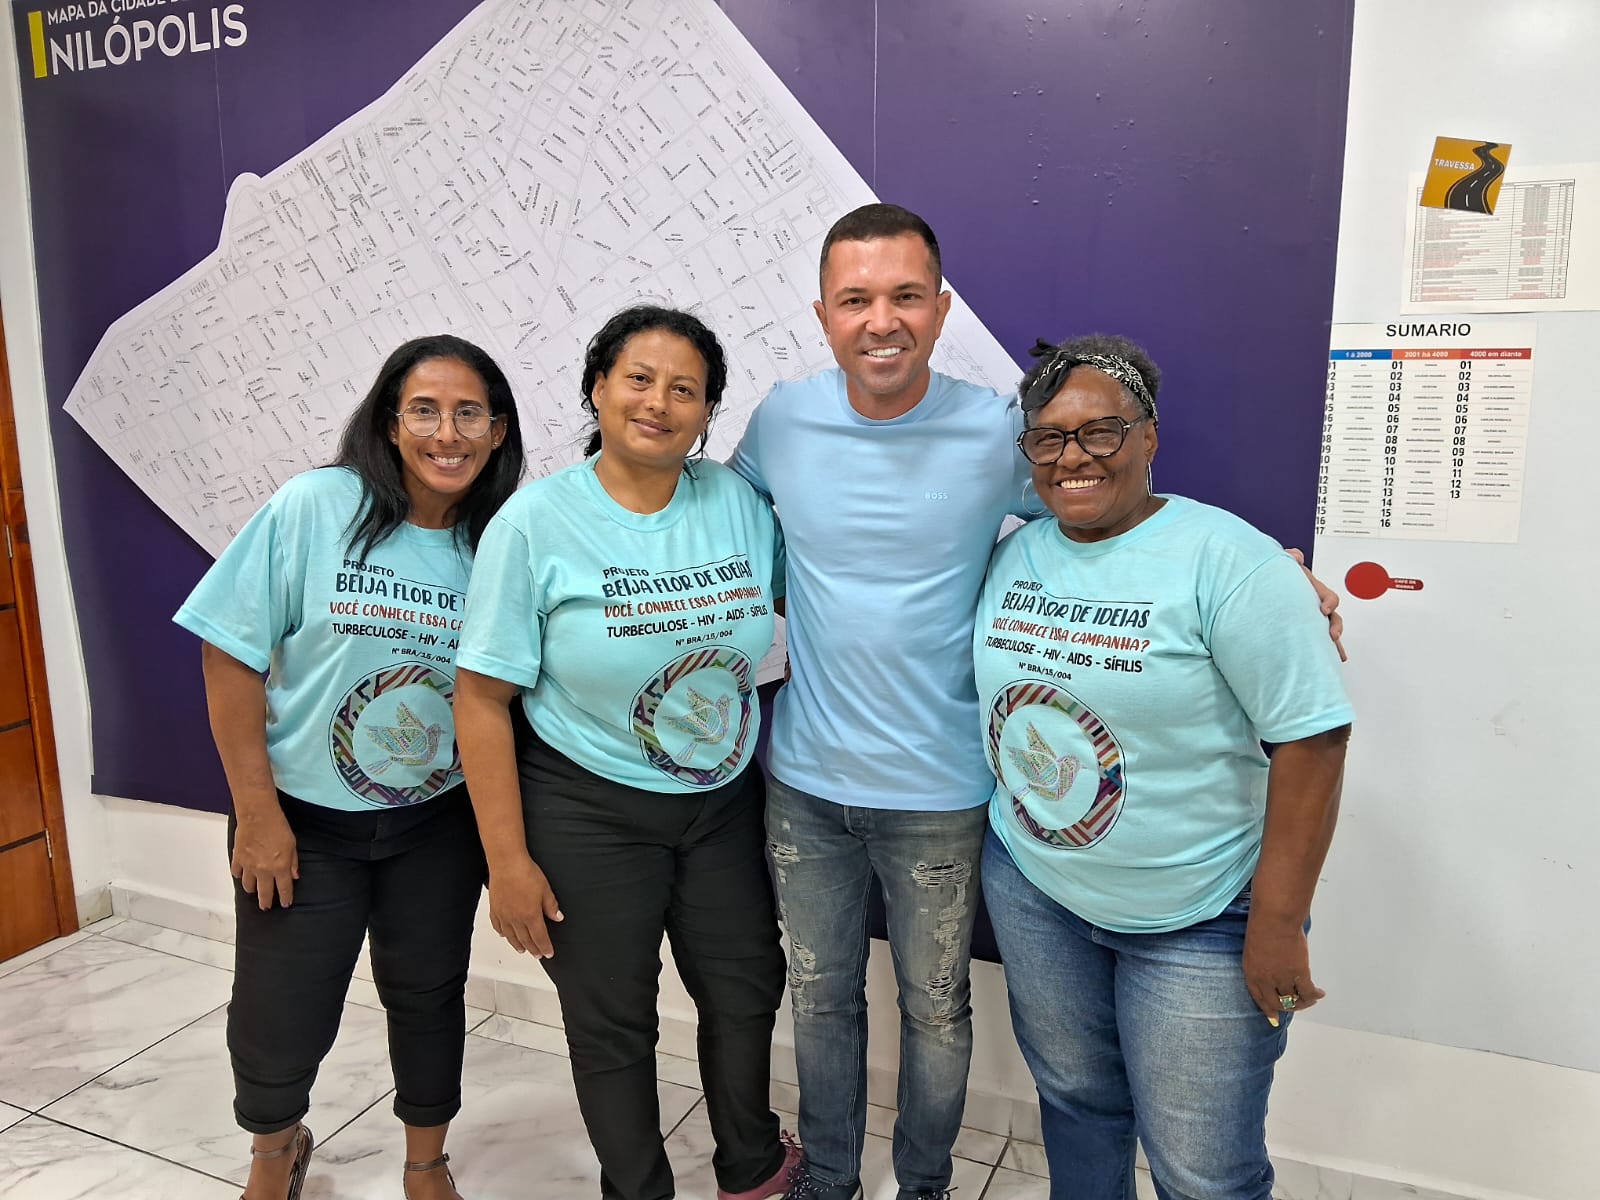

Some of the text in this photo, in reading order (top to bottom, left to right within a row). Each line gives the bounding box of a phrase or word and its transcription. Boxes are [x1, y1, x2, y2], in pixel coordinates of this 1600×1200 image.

[47, 0, 166, 25] MAPA DA CIDA
[50, 4, 248, 75] NILÓPOLIS
[1434, 159, 1475, 170] TRAVESSA
[1386, 324, 1471, 337] SUMARIO
[1392, 361, 1403, 369] 01
[1460, 361, 1472, 369] 01
[1390, 372, 1402, 380] 02
[1459, 372, 1471, 380] 02
[1390, 383, 1401, 391] 03
[1458, 383, 1470, 391] 03
[1388, 393, 1400, 402] 04
[1457, 394, 1469, 402] 04
[1388, 404, 1400, 412] 05
[1456, 405, 1468, 413] 05
[1387, 415, 1399, 423] 06
[1455, 415, 1467, 424] 06
[1386, 425, 1398, 434] 07
[1454, 426, 1466, 435] 07
[1386, 436, 1398, 444] 08
[1453, 437, 1465, 445] 08
[1385, 446, 1396, 454] 09
[1452, 448, 1464, 456] 09
[1384, 457, 1396, 465] 10
[1452, 459, 1463, 467] 10
[1385, 467, 1394, 475] 11
[1453, 469, 1462, 477] 11
[1384, 478, 1394, 486] 12
[1451, 480, 1461, 488] 12
[1383, 488, 1393, 496] 13
[1450, 490, 1460, 498] 13
[1381, 509, 1391, 517] 15
[1380, 519, 1391, 527] 16
[343, 560, 394, 578] PROJETO
[602, 578, 653, 598] BEIJA
[653, 574, 694, 594] FLOR
[694, 570, 717, 588] DE
[336, 573, 388, 597] BEIJA
[393, 582, 432, 606] FLOR
[438, 592, 458, 612] DE
[604, 601, 634, 618] VOCÊ
[637, 598, 688, 615] CONHECE
[689, 596, 717, 609] ESSA
[1002, 591, 1036, 614] BEIJA
[1070, 604, 1093, 623] DE
[1092, 607, 1151, 628] IDEIAS
[330, 599, 360, 615] VOCÊ
[362, 604, 416, 622] CONHECE
[420, 612, 447, 628] ESSA
[607, 619, 688, 638] TURBECULOSE
[697, 614, 715, 627] HIV
[726, 608, 745, 622] AIDS
[332, 623, 408, 640] TURBECULOSE
[418, 633, 439, 646] HIV
[1008, 620, 1050, 638] CONHECE
[1048, 627, 1070, 642] ESSA
[1071, 632, 1150, 652] CAMPANHA?
[985, 636, 1036, 654] TURBECULOSE
[1043, 648, 1061, 660] HIV
[1067, 651, 1093, 667] AIDS
[1104, 655, 1143, 673] SÍFILIS
